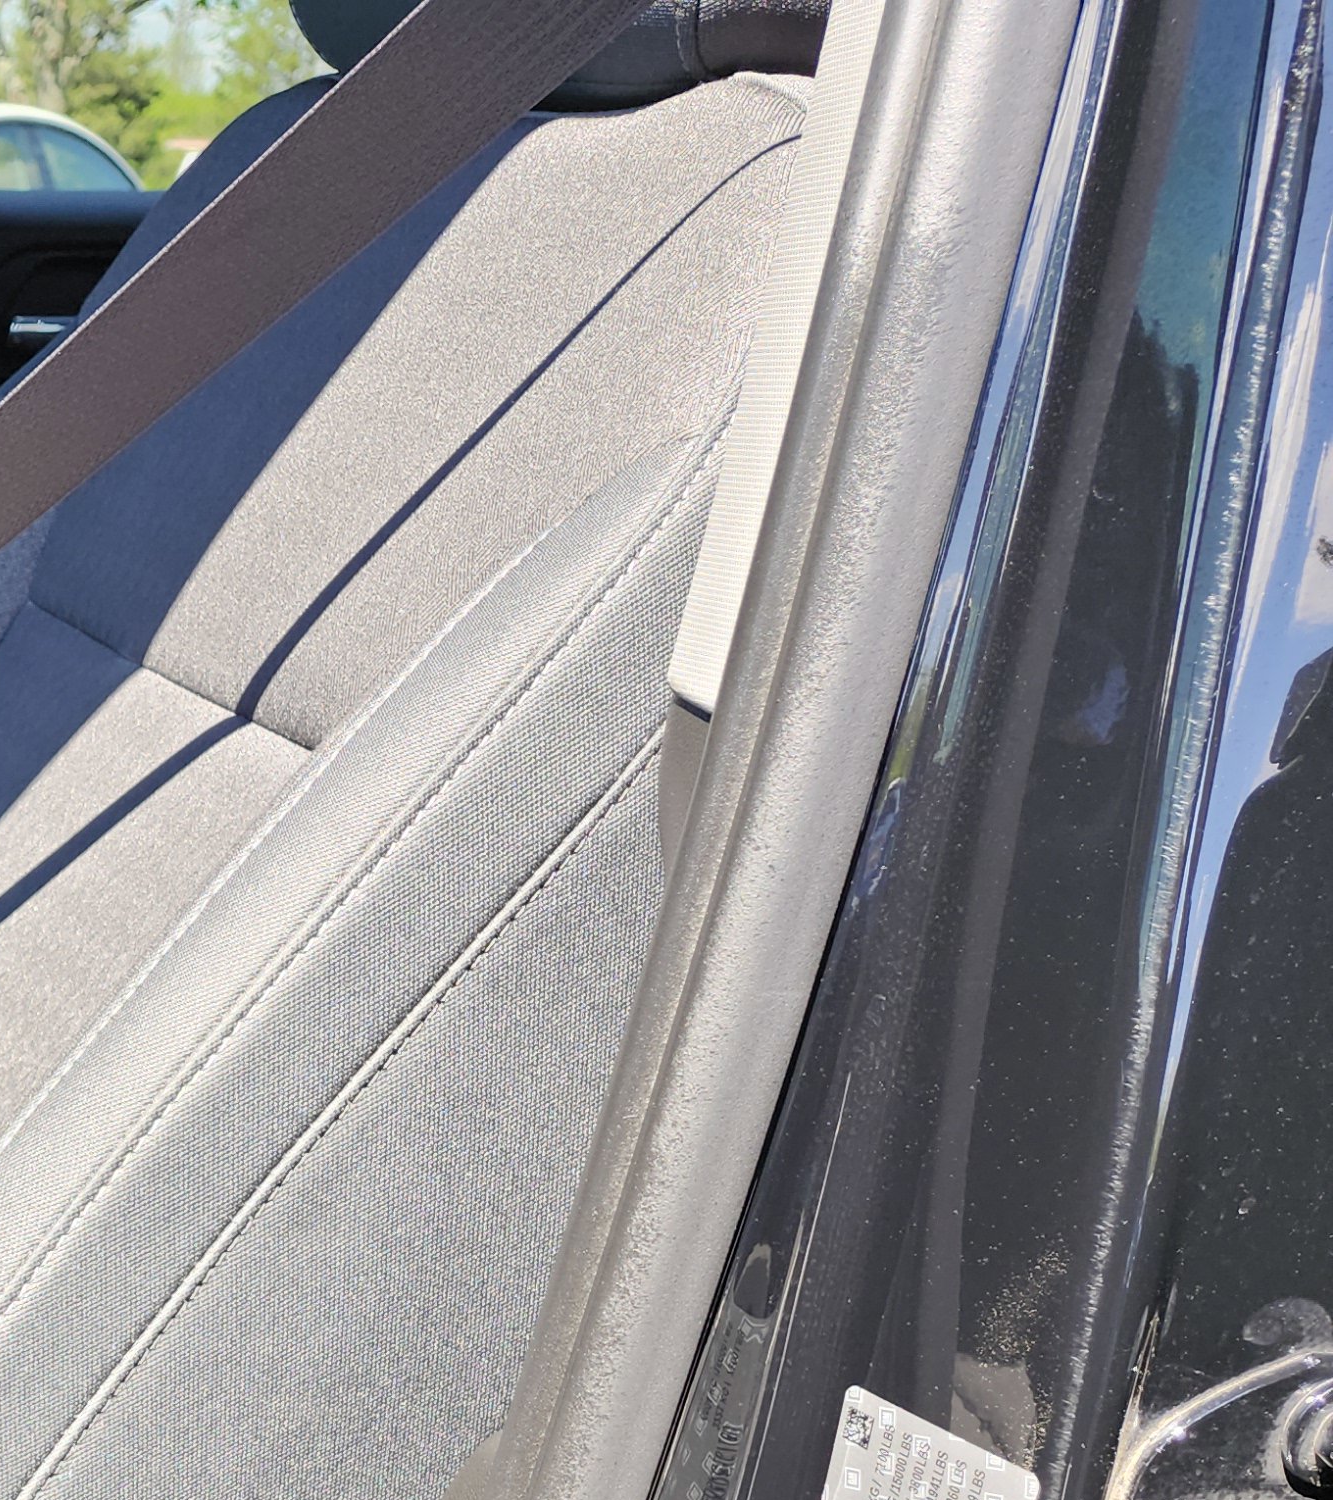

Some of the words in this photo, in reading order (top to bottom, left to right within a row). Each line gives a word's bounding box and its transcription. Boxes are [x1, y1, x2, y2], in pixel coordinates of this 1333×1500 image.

[880, 1421, 896, 1449] LBS
[897, 1430, 915, 1458] LBS
[932, 1448, 950, 1477] LBS
[907, 1465, 925, 1496] 3800
[968, 1466, 987, 1496] LBS
